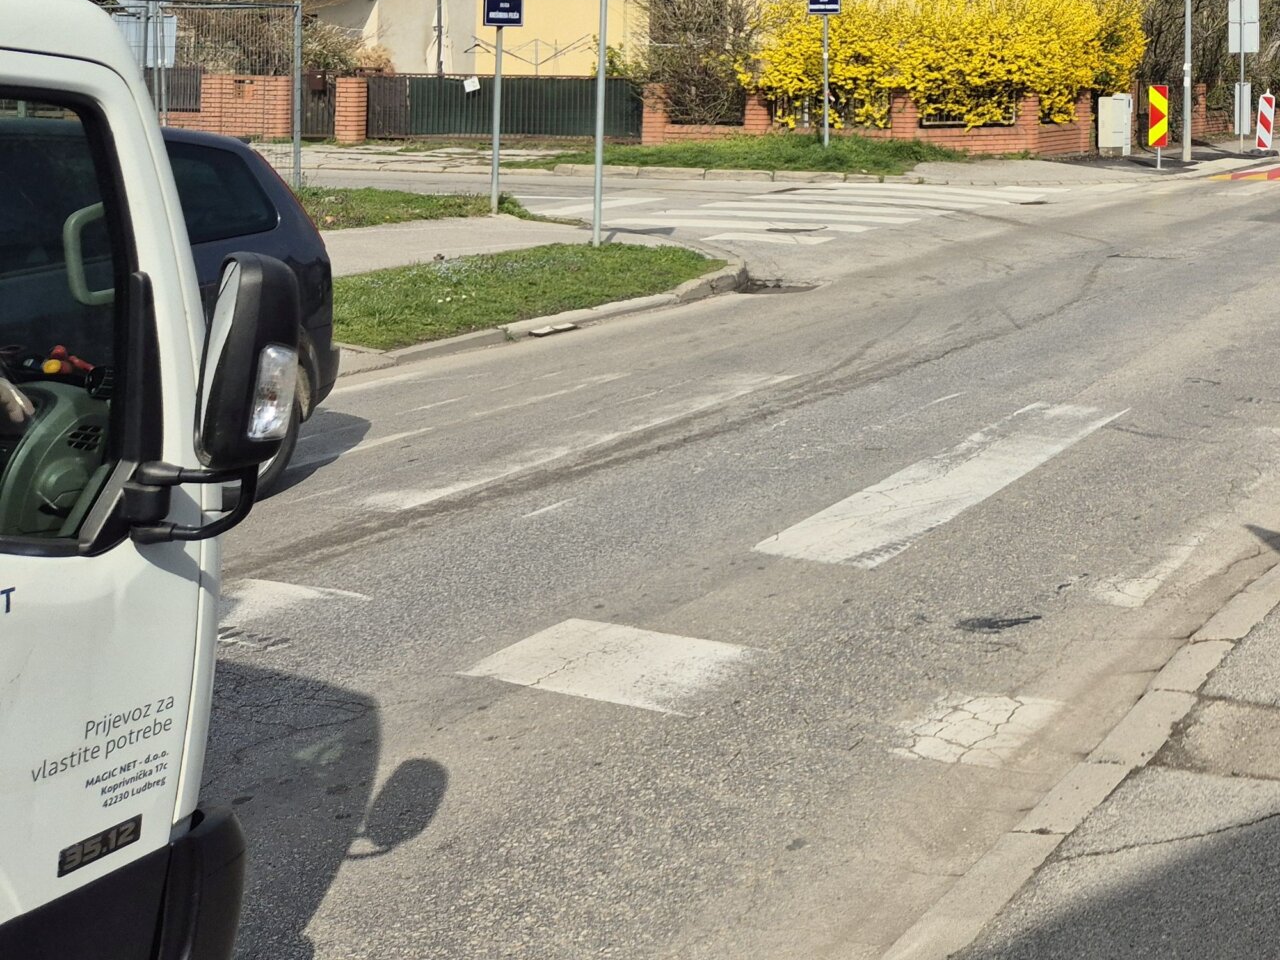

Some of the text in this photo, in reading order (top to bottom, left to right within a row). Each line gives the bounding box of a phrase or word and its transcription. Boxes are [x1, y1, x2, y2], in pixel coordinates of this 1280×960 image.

[84, 695, 175, 739] Prijevoz za
[31, 717, 173, 782] vlastite potrebe
[85, 767, 118, 789] MAGIC
[119, 759, 138, 774] NET
[144, 750, 169, 764] d.o.o.
[100, 761, 169, 796] Koprivnička 17c
[102, 776, 167, 808] 42230 Ludbreg
